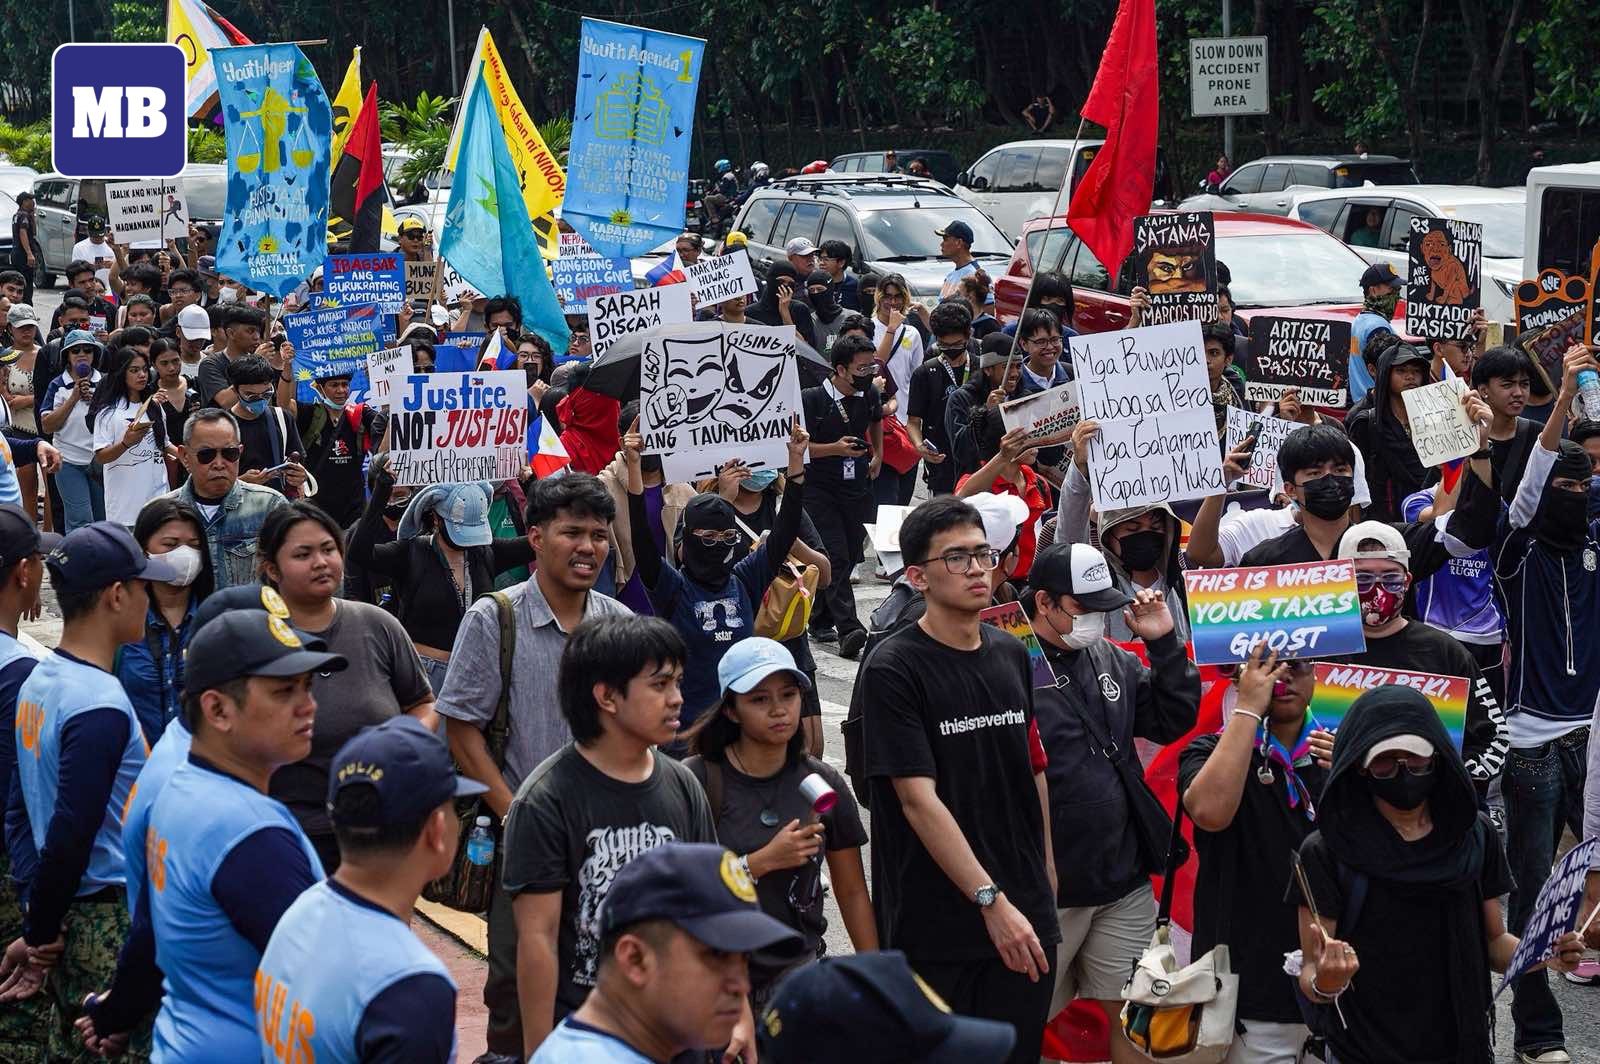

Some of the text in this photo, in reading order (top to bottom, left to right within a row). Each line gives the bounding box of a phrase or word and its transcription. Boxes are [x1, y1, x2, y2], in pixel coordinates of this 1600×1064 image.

[1195, 44, 1263, 59] SLOW DOWN
[1199, 62, 1261, 75] ACCIDENT
[1209, 79, 1251, 90] PRONE
[1214, 95, 1247, 106] AREA
[509, 103, 528, 140] laban
[525, 137, 542, 153] ni
[110, 188, 130, 199] IBALIK
[132, 189, 145, 197] ANG
[122, 204, 154, 214] HINDI ANG
[1144, 213, 1200, 226] KAHIT SI
[1137, 222, 1210, 254] SATANAS
[1446, 219, 1482, 242] MARCOS
[247, 253, 298, 269] KABATAAN
[250, 263, 306, 278] PARTYLIST
[332, 257, 397, 273] IBAGSAK
[552, 259, 613, 273] BONGBONG
[690, 255, 734, 279] MAKIBAKA
[1413, 266, 1427, 276] ARF
[1453, 240, 1480, 288] TUTA
[352, 271, 374, 281] ANG
[556, 270, 632, 285] GO GIRL GIVE
[699, 269, 730, 286] HUWAG
[1413, 275, 1430, 286] ARF
[329, 281, 400, 293] BURUKRATANG
[405, 280, 437, 295] BULS
[697, 277, 745, 303] MATAKOT
[342, 292, 404, 303] KAPITALISMO
[594, 291, 660, 321] SARAH
[1142, 304, 1189, 328] MARCOS
[596, 313, 661, 340] DISCAYA
[1269, 321, 1331, 341] ARTISTA
[1407, 318, 1477, 341] PASISTA
[727, 331, 783, 350] GISING
[1268, 339, 1326, 360] KONTRA
[311, 350, 326, 362] NG
[1072, 336, 1200, 383] Mga Buwaya
[1080, 371, 1213, 428] Lubog sa Pera
[1229, 408, 1241, 428] WE
[391, 411, 436, 451] NOT
[644, 430, 677, 449] ANG
[1089, 427, 1131, 475] Mga
[1128, 417, 1218, 460] Gahaman
[1094, 452, 1227, 508] Kapal ng Muka
[1186, 563, 1354, 593] THIS IS WHERE
[1450, 566, 1481, 578] RUGBY
[1193, 592, 1357, 625] YOUR TAXES
[1229, 625, 1328, 658] GHOST
[1325, 667, 1387, 691] MAKI
[939, 709, 1026, 736] thisisneverthat
[338, 761, 384, 783] PULIS
[254, 968, 316, 1064] PULIS
